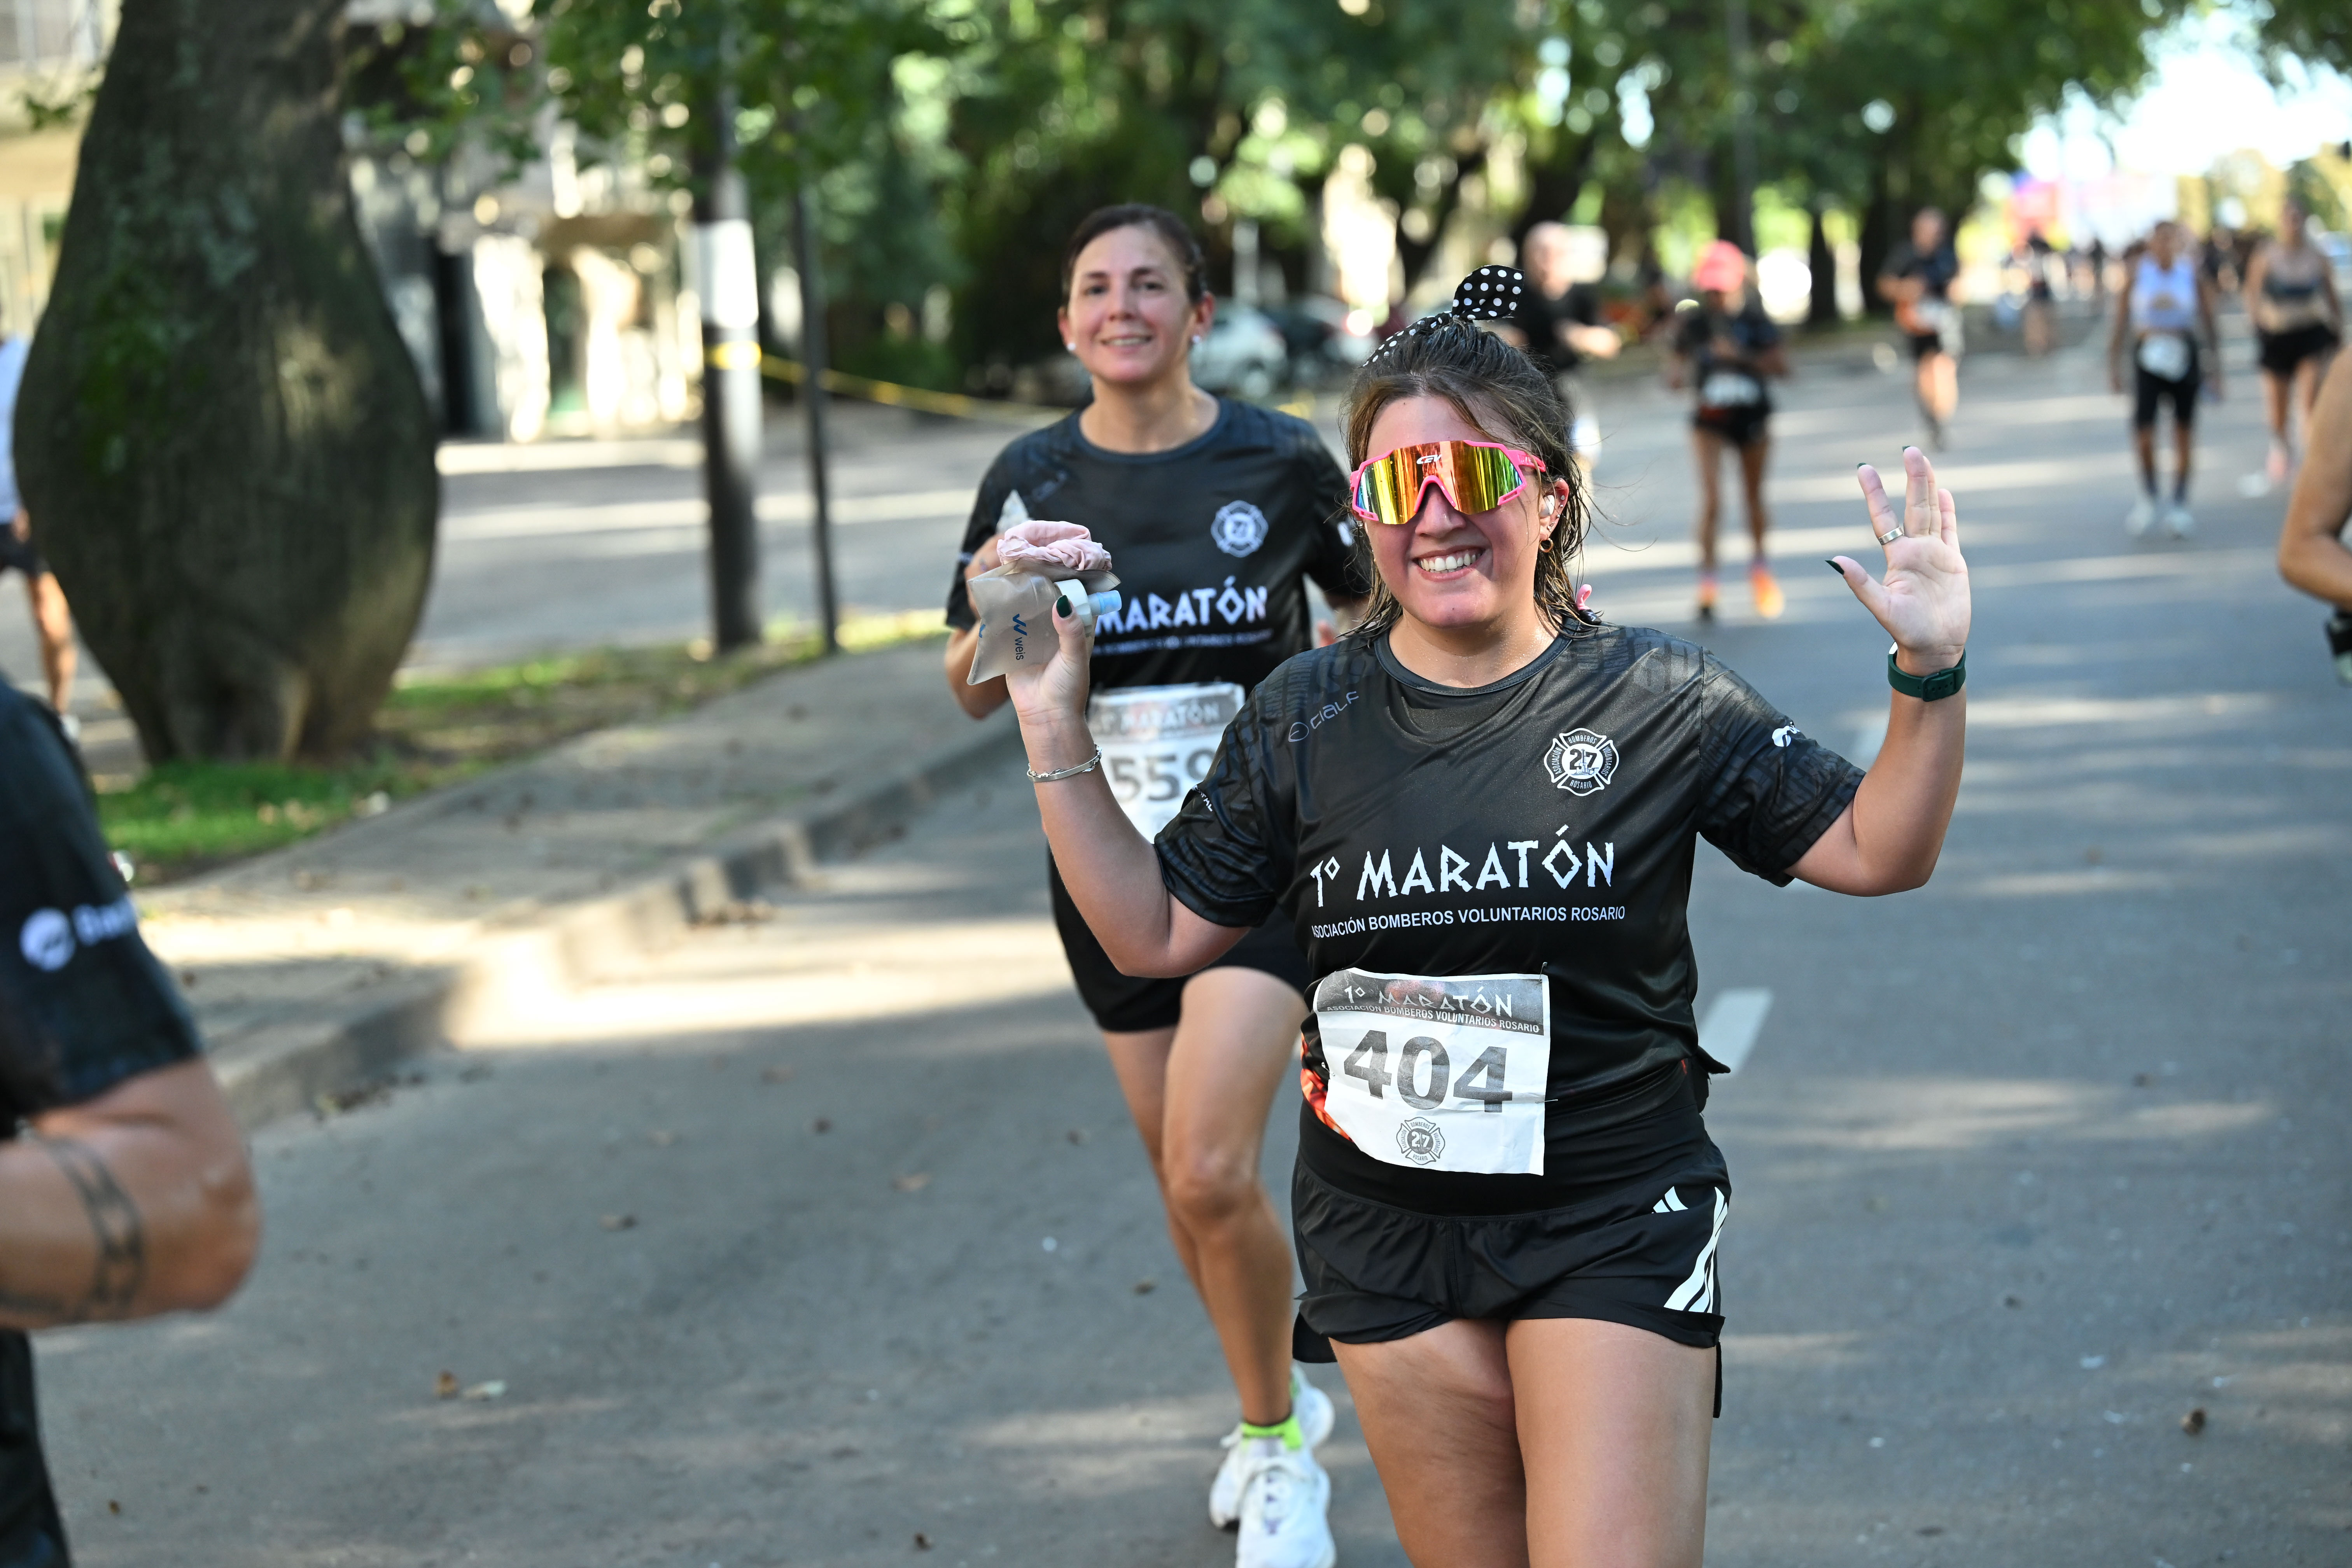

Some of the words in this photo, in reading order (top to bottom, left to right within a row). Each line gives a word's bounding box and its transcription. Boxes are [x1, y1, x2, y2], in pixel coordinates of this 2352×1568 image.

[1095, 575, 1268, 637] MARATÓN
[1015, 637, 1026, 660] weis
[1568, 735, 1597, 744] BOMBEROS
[1552, 747, 1563, 775] ASOCIACIÓN
[1570, 749, 1597, 770] 27
[1601, 746, 1612, 776] VOLUNTARIOS
[1570, 780, 1592, 789] ROSARIO
[1356, 824, 1614, 901] MARATÓN
[1312, 917, 1365, 938] ASOCIACIÓN
[1369, 910, 1453, 930] BOMBEROS
[1458, 906, 1566, 922] VOLUNTARIOS
[1571, 905, 1625, 920] ROSARIO
[1379, 986, 1512, 1018] MARATÓN
[1384, 1006, 1433, 1019] BOMBEROS
[1435, 1010, 1496, 1027] VOLUNTARIOS
[1499, 1019, 1540, 1033] ROSARIO
[1344, 1030, 1513, 1113] 404
[1412, 1131, 1430, 1147] 27
